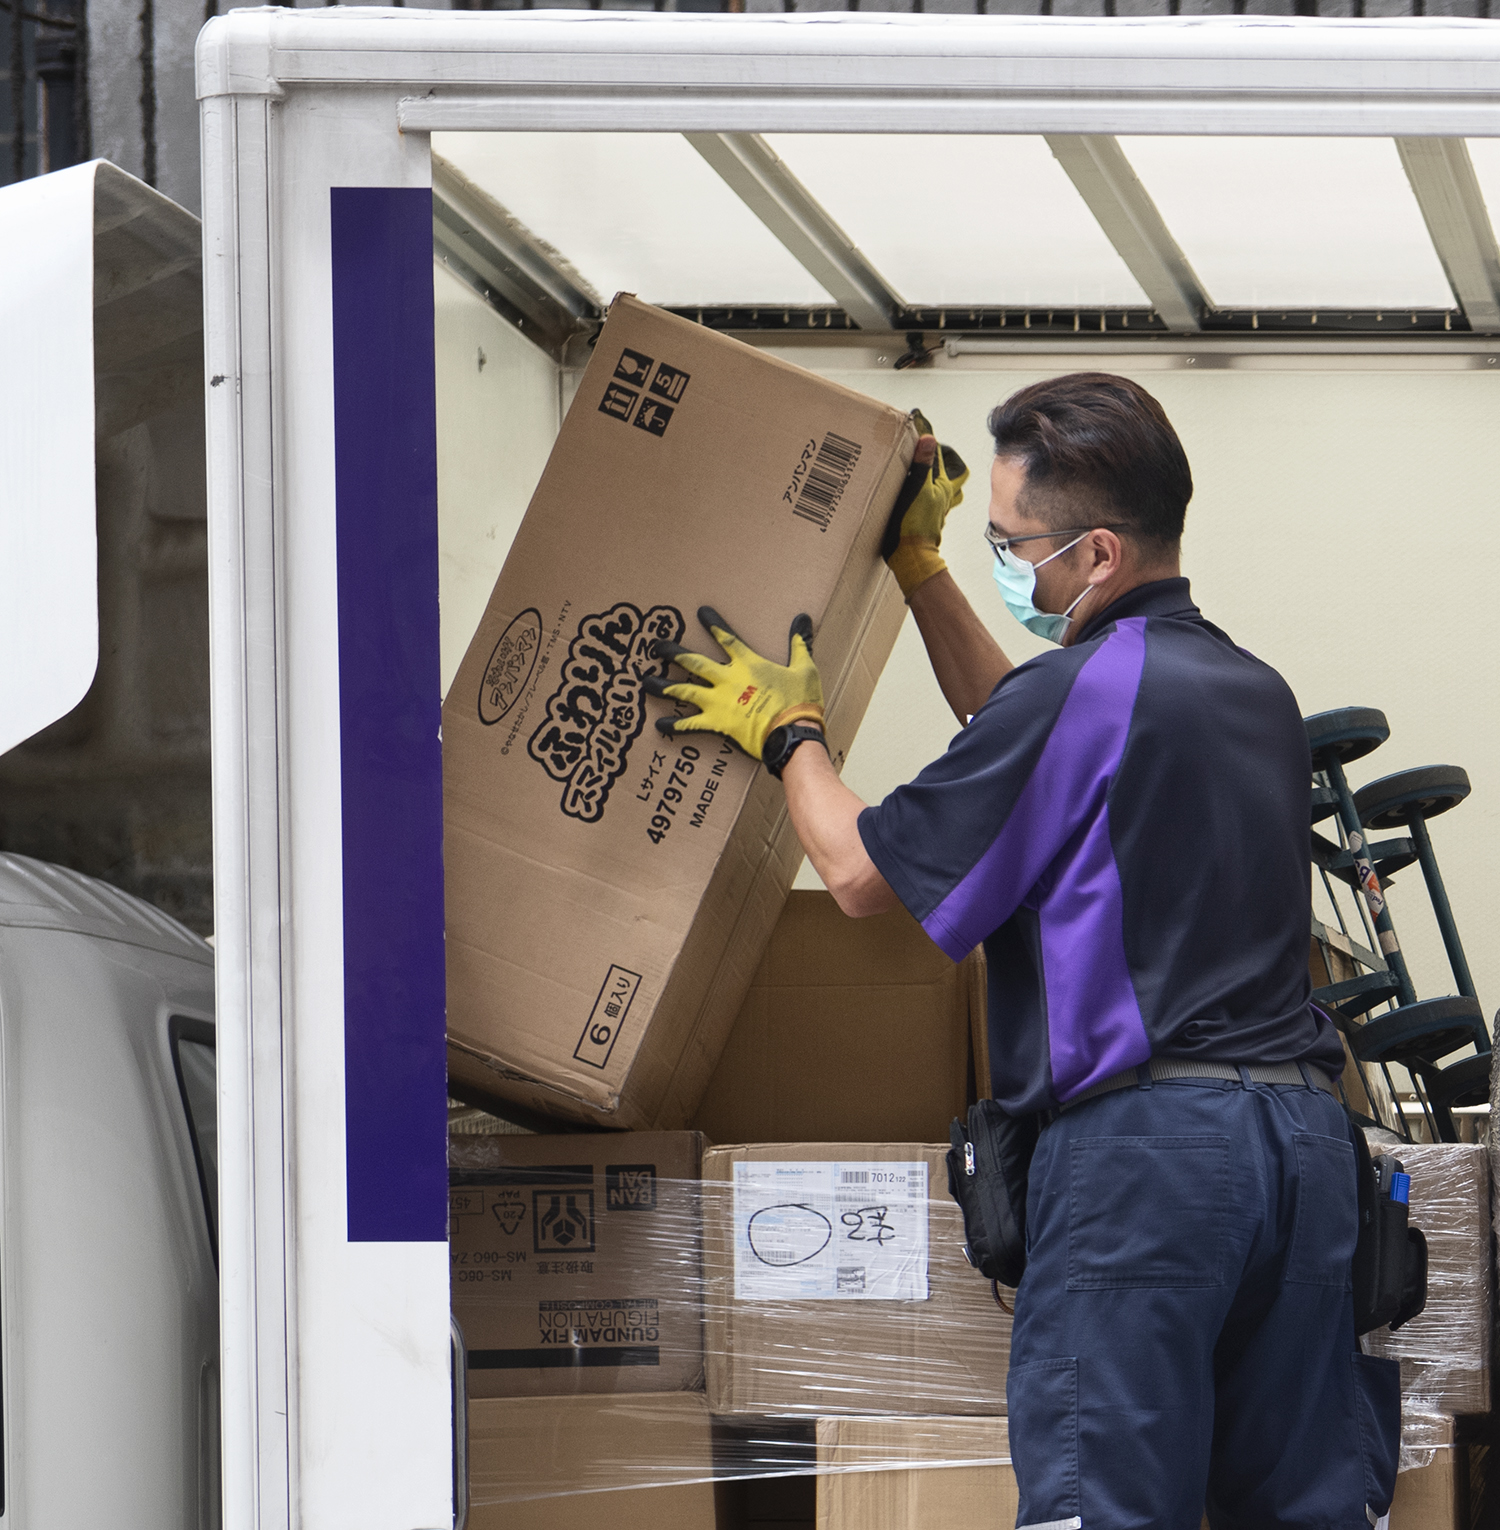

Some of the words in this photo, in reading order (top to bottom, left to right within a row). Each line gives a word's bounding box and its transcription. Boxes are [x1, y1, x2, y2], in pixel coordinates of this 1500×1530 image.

[736, 684, 758, 706] 3M
[645, 744, 701, 845] 4979750
[689, 778, 719, 828] MADE
[711, 758, 728, 777] IN
[871, 1172, 895, 1183] 7012
[538, 1310, 660, 1329] FIGURATION
[540, 1328, 570, 1344] FIX
